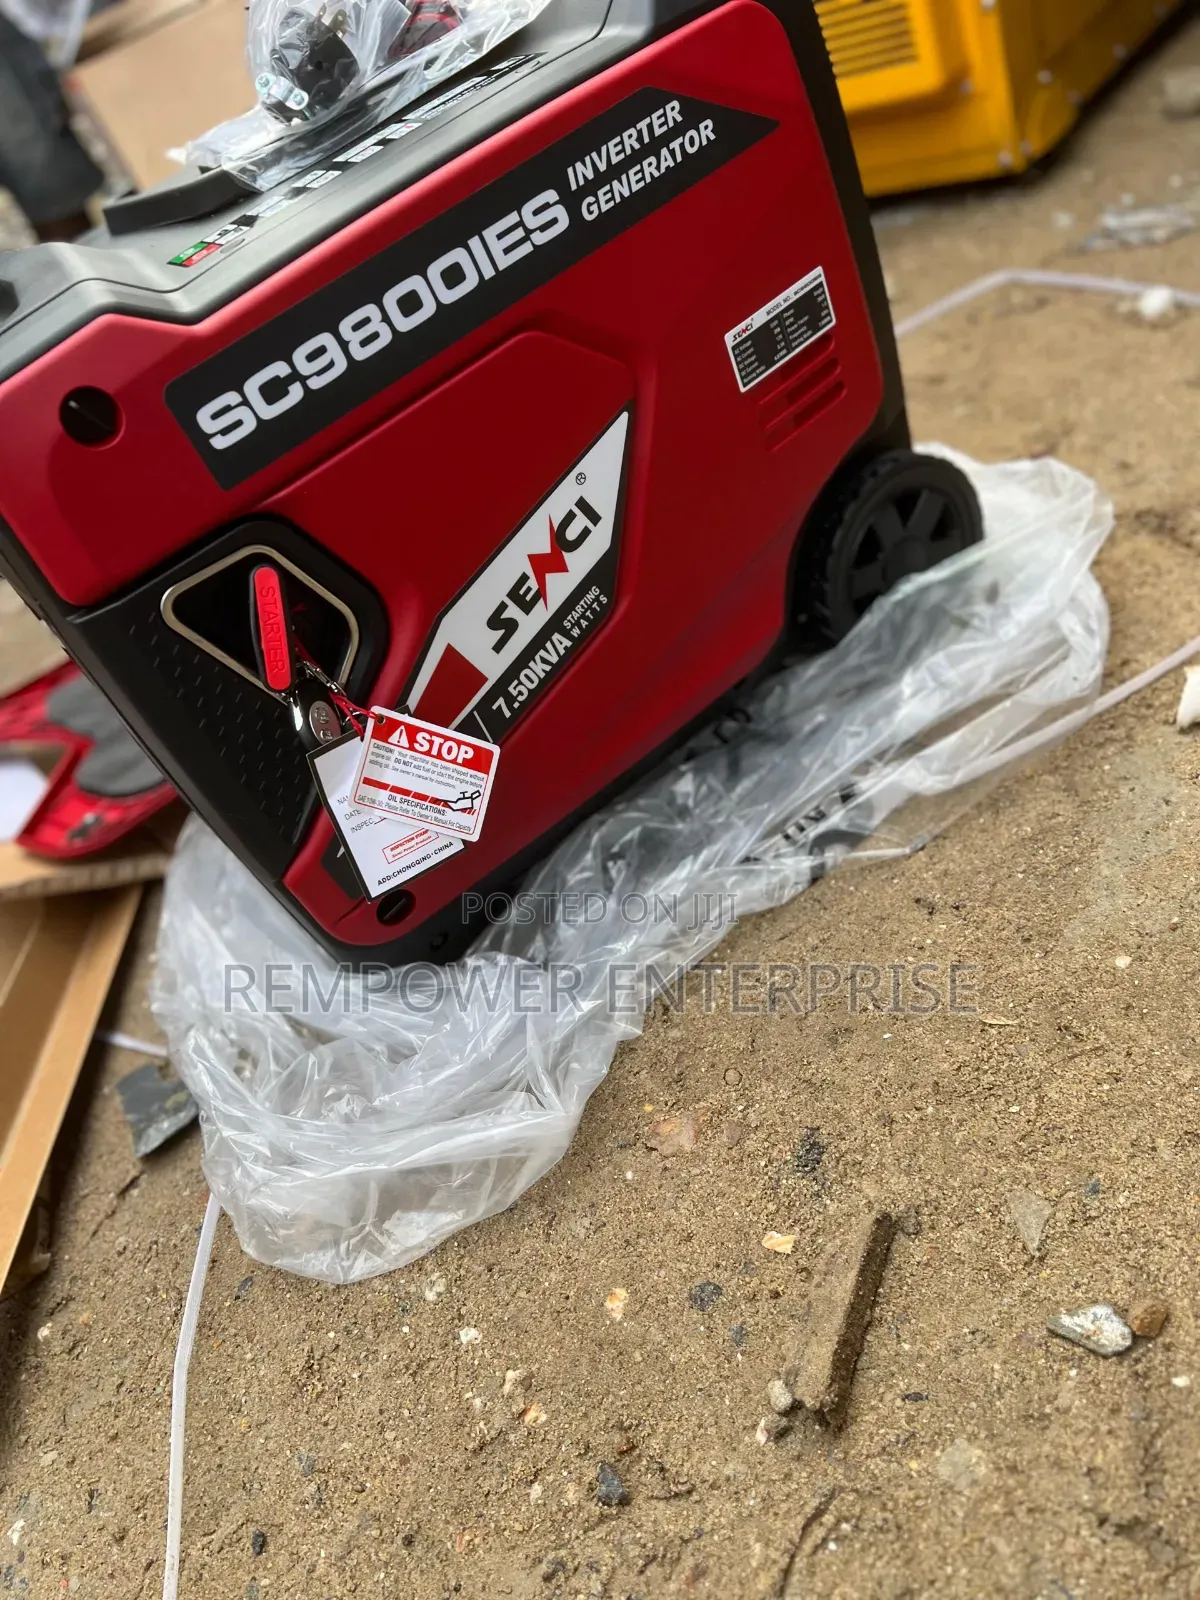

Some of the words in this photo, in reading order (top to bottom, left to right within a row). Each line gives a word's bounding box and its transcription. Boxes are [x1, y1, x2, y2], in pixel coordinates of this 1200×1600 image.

[566, 99, 684, 192] INVERTER
[580, 118, 717, 223] GENERATOR
[195, 187, 571, 450] SC9800IES
[732, 323, 754, 342] SENCI
[486, 495, 602, 655] SENCI
[562, 584, 601, 630] STARTING
[259, 585, 286, 675] STARTER
[491, 632, 573, 720] 7.50KVA
[413, 731, 474, 764] STOP
[402, 760, 414, 768] NOT
[454, 776, 470, 785] engine
[469, 780, 483, 790] before
[408, 754, 430, 766] machine
[452, 767, 469, 778] shipped
[469, 773, 485, 782] without
[384, 802, 399, 812] Please
[398, 805, 411, 815] Refer
[433, 816, 448, 826] Manual
[455, 822, 472, 833] Capacity
[388, 794, 398, 804] OIL
[398, 797, 448, 816] SPECIFICATIONS:
[390, 836, 416, 852] INSPECTION
[404, 844, 416, 854] Power
[415, 835, 432, 846] Products
